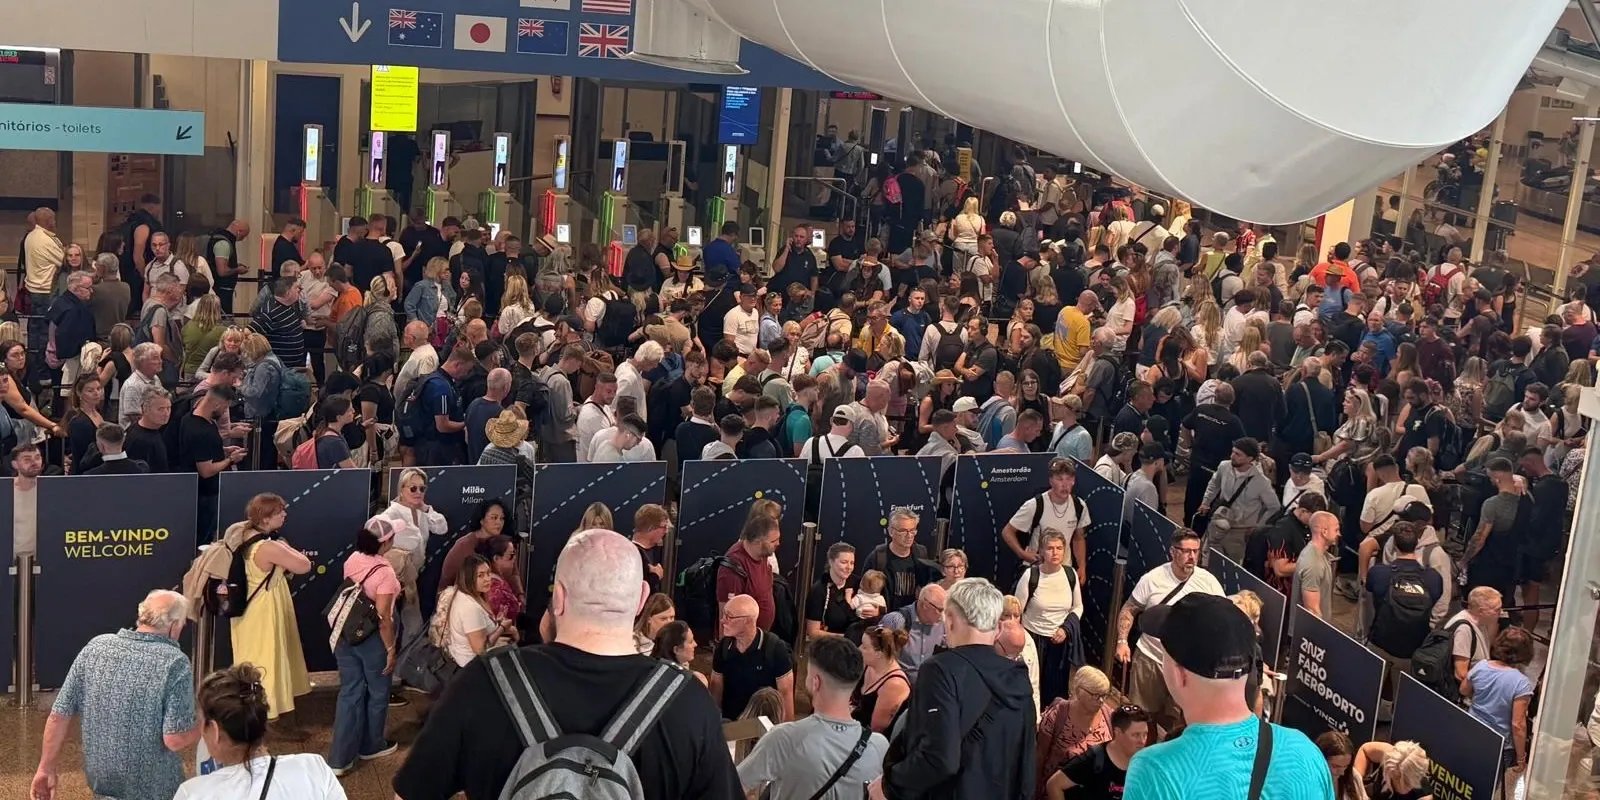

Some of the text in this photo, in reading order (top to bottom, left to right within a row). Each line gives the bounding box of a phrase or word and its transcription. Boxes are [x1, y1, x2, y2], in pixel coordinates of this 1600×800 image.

[62, 122, 101, 134] toilets
[991, 466, 1032, 474] Amesterdão
[462, 485, 486, 494] Milão
[65, 528, 169, 544] BEM-VINDO
[64, 543, 154, 558] WELCOME
[1297, 652, 1327, 681] FARO
[1296, 669, 1365, 723] AEROPORTO
